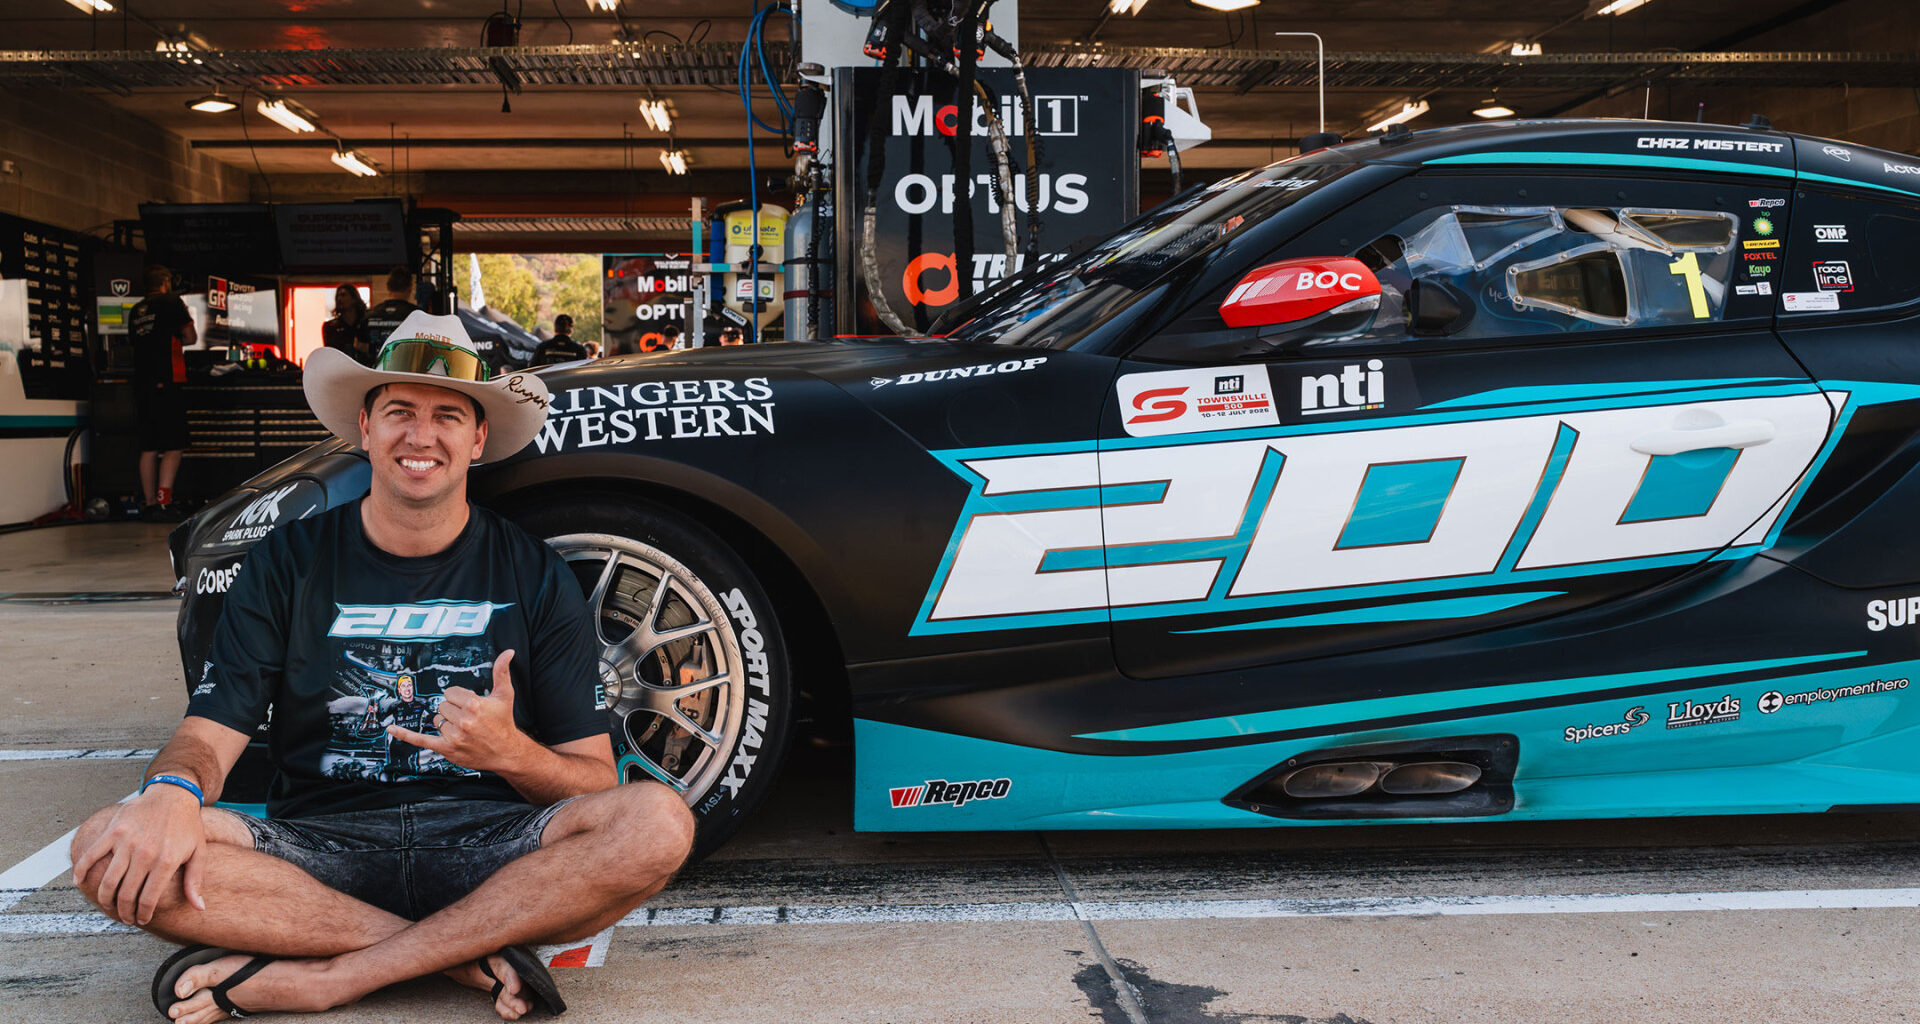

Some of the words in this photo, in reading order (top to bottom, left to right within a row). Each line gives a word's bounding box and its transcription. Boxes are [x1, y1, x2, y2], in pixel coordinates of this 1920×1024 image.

[892, 95, 1025, 136] Mobil
[1636, 137, 1690, 149] CHAZ
[1693, 139, 1784, 153] MOSTERT
[894, 173, 1089, 214] OPTUS
[1758, 199, 1785, 208] Repco
[1815, 228, 1847, 239] OMP
[1743, 252, 1777, 260] FOXTEL
[1749, 265, 1771, 276] Kayo
[1818, 265, 1845, 273] race
[1820, 273, 1848, 284] line
[637, 276, 687, 292] Mobil
[1296, 271, 1362, 291] BOC
[1668, 252, 1710, 318] 1
[209, 289, 226, 308] GR
[636, 304, 707, 320] OPT
[896, 356, 1047, 385] DUNLOP
[1219, 377, 1240, 392] nti
[1301, 358, 1384, 411] nti
[1197, 393, 1267, 404] TOWNSVILLE
[1224, 402, 1243, 410] 500
[533, 403, 775, 454] WESTERN
[229, 482, 299, 528] NGK
[922, 391, 1845, 625] 200
[222, 528, 244, 541] SPARK
[1867, 597, 1920, 632] SUP
[719, 587, 770, 697] SPORT
[1668, 695, 1740, 721] Lloyds
[1564, 721, 1631, 744] Spicers
[719, 697, 770, 800] MAXX
[921, 778, 1012, 807] Repco
